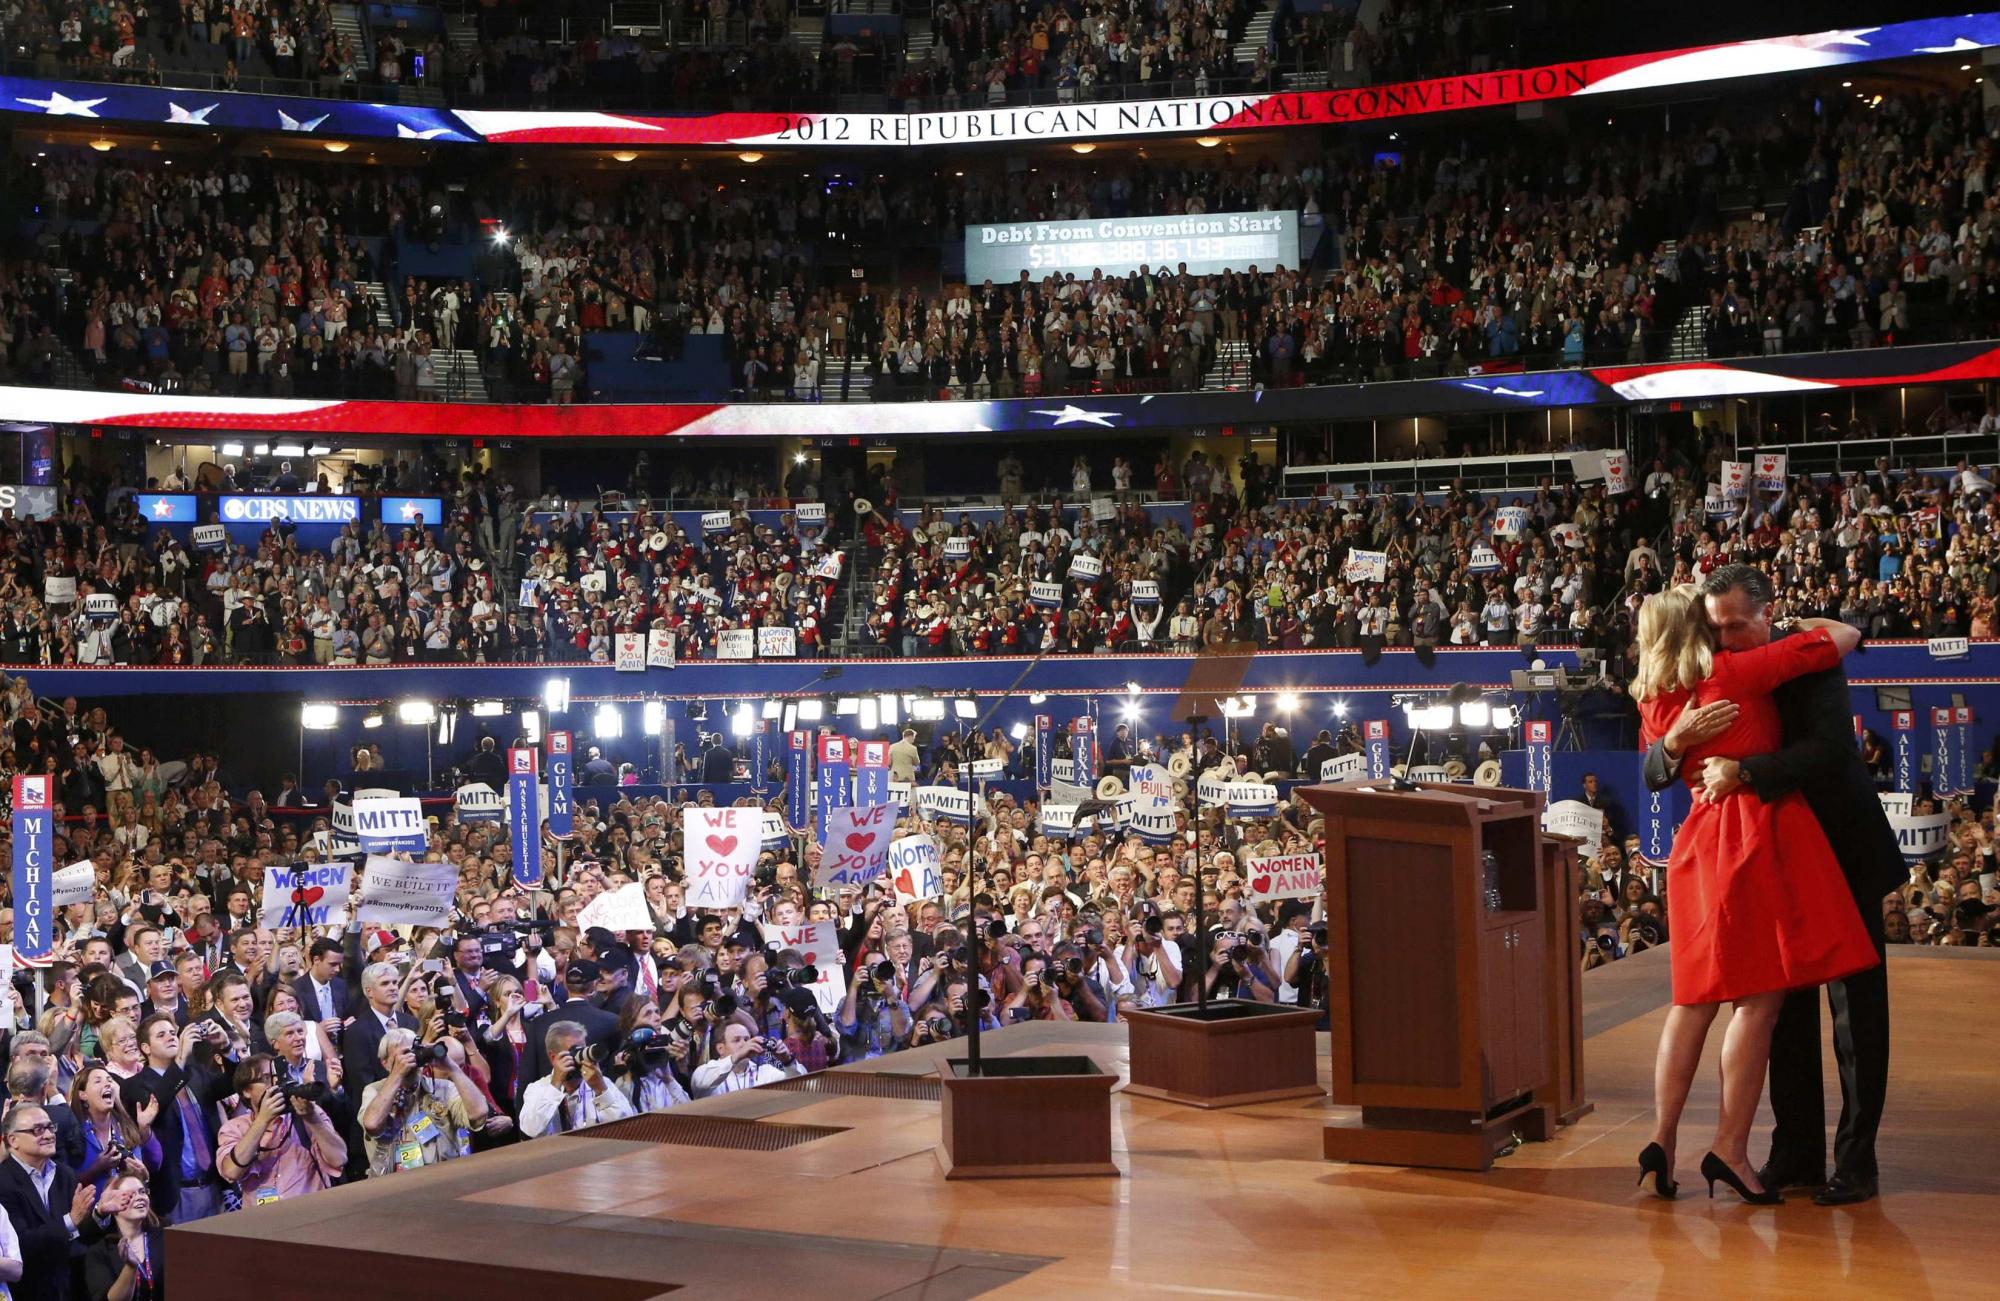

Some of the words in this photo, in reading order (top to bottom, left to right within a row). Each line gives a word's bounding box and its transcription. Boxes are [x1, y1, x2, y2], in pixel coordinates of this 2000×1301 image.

[776, 117, 851, 141] 2012
[869, 106, 1098, 140] REPUBLICAN
[1117, 96, 1313, 130] NATIONAL
[1328, 65, 1590, 120] CONVENTION
[981, 226, 1032, 245] Debt
[1035, 223, 1094, 243] From
[1098, 217, 1225, 239] Convention
[1228, 214, 1283, 235] Start
[244, 498, 288, 519] CBS
[293, 499, 357, 521] NEWS
[798, 508, 824, 516] MITT!
[702, 516, 729, 526] MITT!
[195, 529, 223, 541] MITT!
[1073, 559, 1102, 573] MITT!
[1032, 586, 1061, 597] MITT!
[88, 599, 116, 608] MITT
[762, 641, 792, 655] ANN
[1931, 640, 1967, 652] MITT!
[1323, 758, 1357, 777] MITT!
[1899, 733, 1910, 792] ALASK
[1936, 729, 1949, 792] WYOMING
[823, 768, 833, 787] US
[1053, 765, 1074, 777] MIT
[1542, 745, 1551, 807] COLUMBIA
[554, 762, 568, 815] GUAM
[867, 771, 878, 795] NEW
[1141, 781, 1172, 799] BUILT
[1228, 787, 1275, 800] MITT!
[937, 796, 977, 812] MITT!
[358, 810, 420, 831] MITT!
[703, 809, 737, 829] WE
[850, 805, 886, 828] WE
[1132, 811, 1175, 829] MITT!
[518, 779, 530, 877] MASSACHUSETTS
[1651, 819, 1660, 856] RICO
[1251, 856, 1315, 874] WOMEN
[24, 818, 42, 949] MICHIGAN
[372, 875, 391, 887] WE
[395, 877, 435, 891] BUILT
[437, 881, 450, 892] IT
[366, 900, 444, 914] #RomneyRyan2012
[781, 926, 818, 947] WE
[412, 1124, 420, 1133] 2
[401, 1152, 410, 1161] 2
